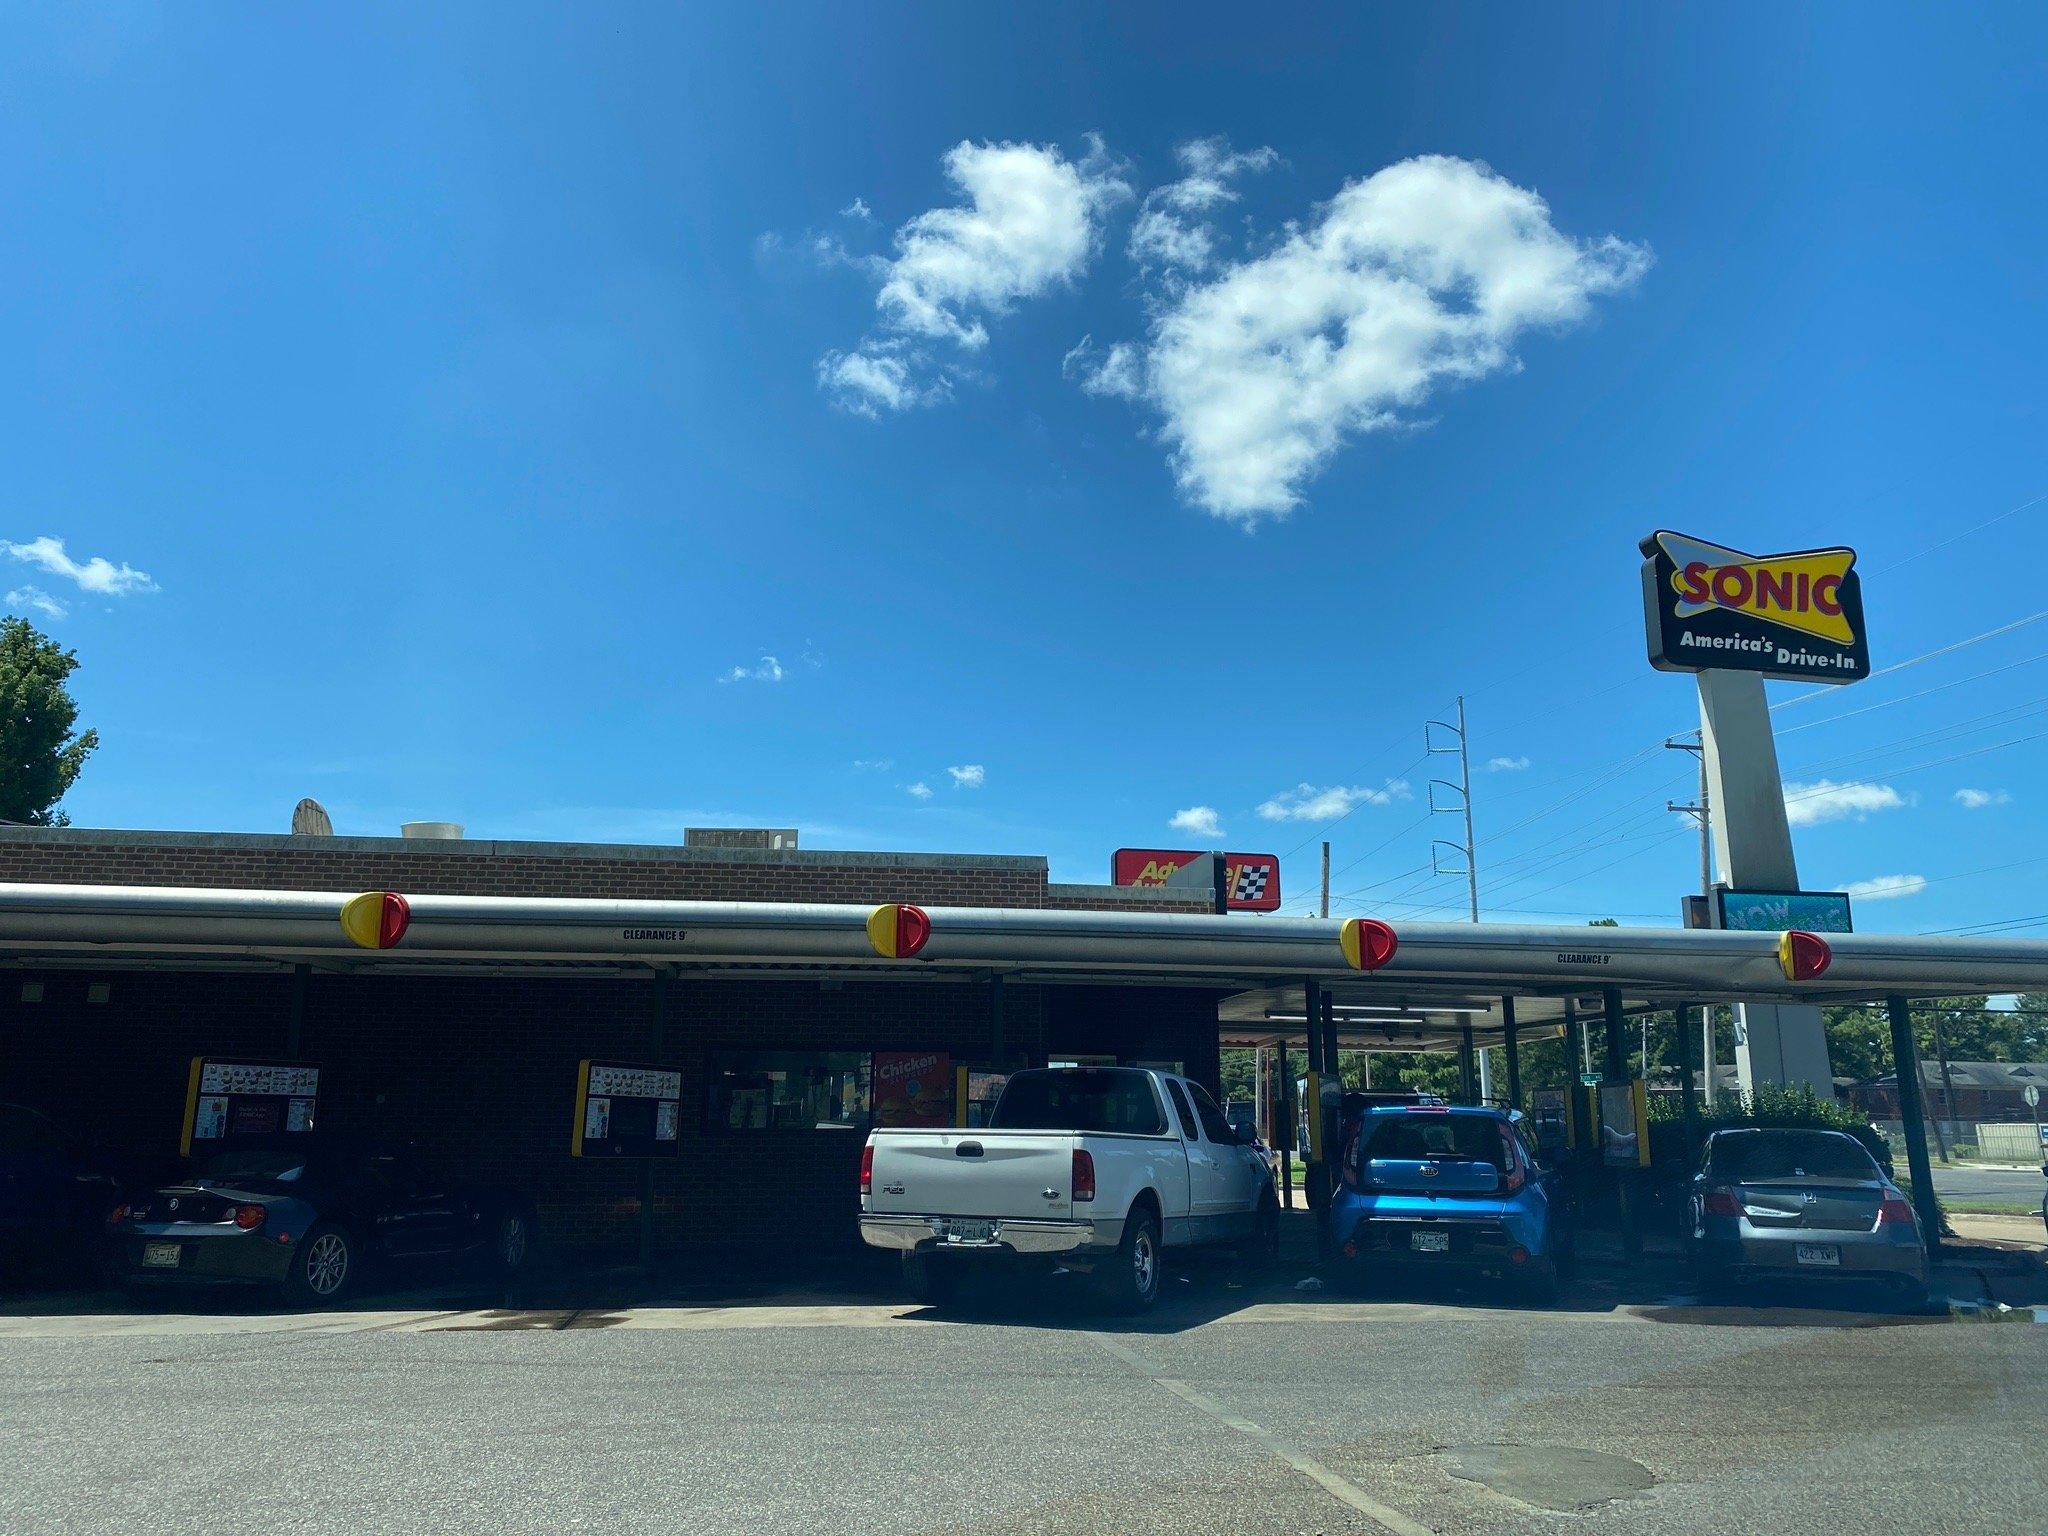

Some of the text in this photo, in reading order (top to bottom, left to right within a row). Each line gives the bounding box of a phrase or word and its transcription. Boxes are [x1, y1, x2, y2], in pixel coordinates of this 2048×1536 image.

[1679, 561, 1844, 616] SONIC
[1680, 630, 1774, 653] America's
[623, 929, 688, 941] CLEARANCE 9'
[1557, 953, 1612, 965] CLEARANCE 9'
[879, 1054, 938, 1080] Chicken
